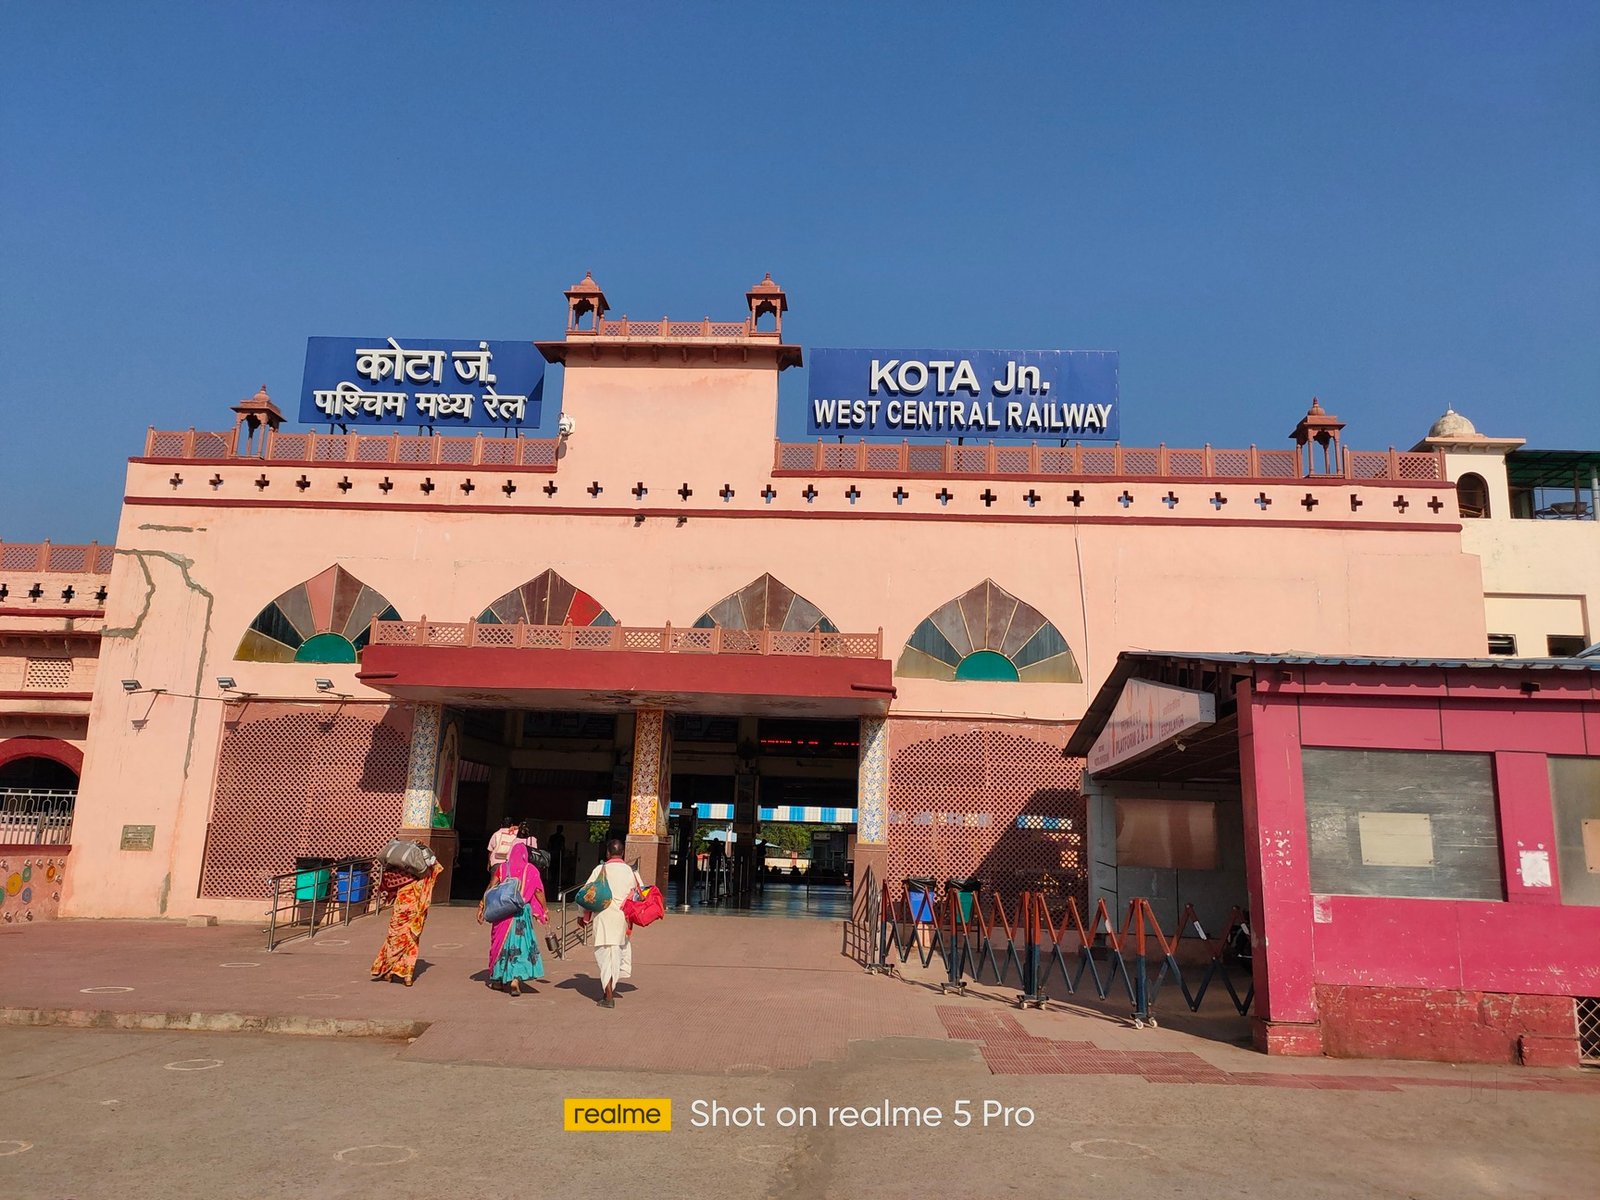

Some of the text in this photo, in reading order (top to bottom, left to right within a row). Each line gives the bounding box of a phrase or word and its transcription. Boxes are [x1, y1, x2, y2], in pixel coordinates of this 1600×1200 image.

[355, 337, 447, 384] कोटा
[870, 359, 1050, 394] KOTA Jn.
[313, 381, 528, 421] पश्चिम मध्य रेल
[814, 399, 1113, 429] WEST CENTRAL RAILWAY
[1115, 730, 1137, 756] PLATFORM
